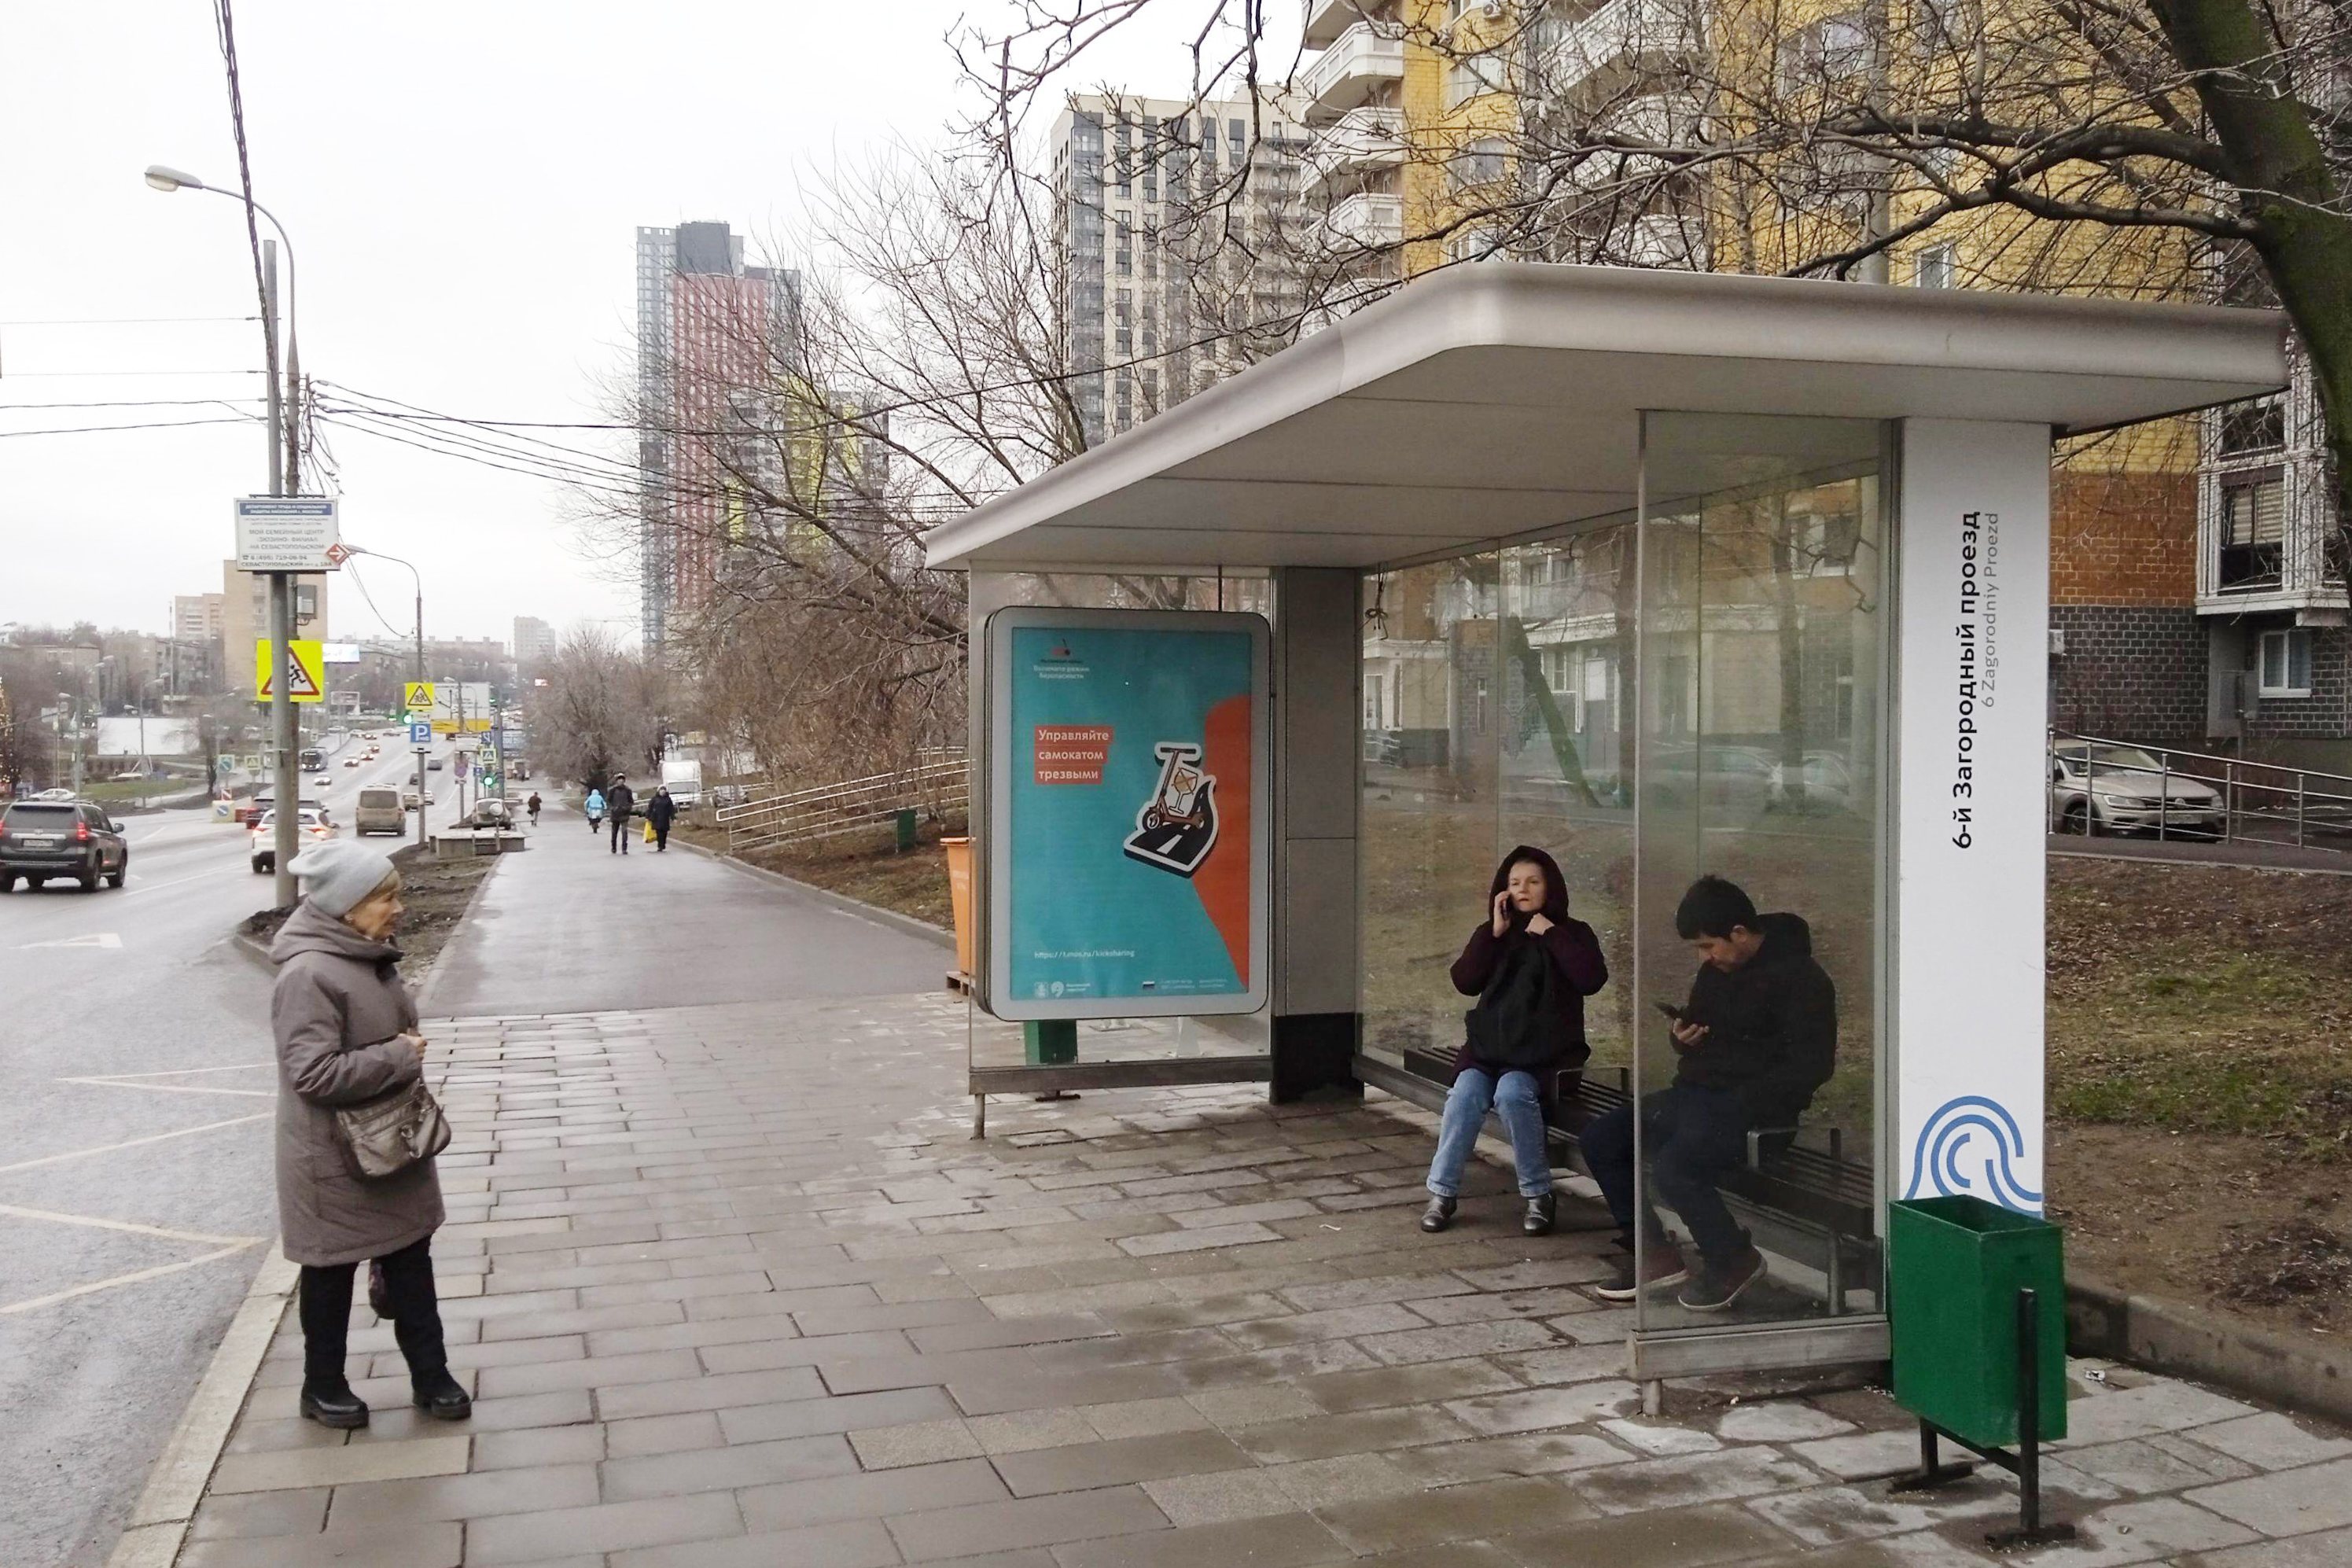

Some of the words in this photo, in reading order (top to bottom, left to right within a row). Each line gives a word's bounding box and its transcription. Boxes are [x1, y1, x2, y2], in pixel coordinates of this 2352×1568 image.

[1961, 511, 1981, 614] проезд
[1983, 512, 1999, 578] Proezd
[1982, 582, 2000, 695] Zagorodniy
[1953, 624, 1978, 799] Загородный
[1981, 696, 1995, 708] 6
[1039, 729, 1110, 744] Управляйте
[1039, 750, 1104, 760] самокатом
[1039, 771, 1099, 782] трезвыми
[1953, 808, 1972, 849] 6-й
